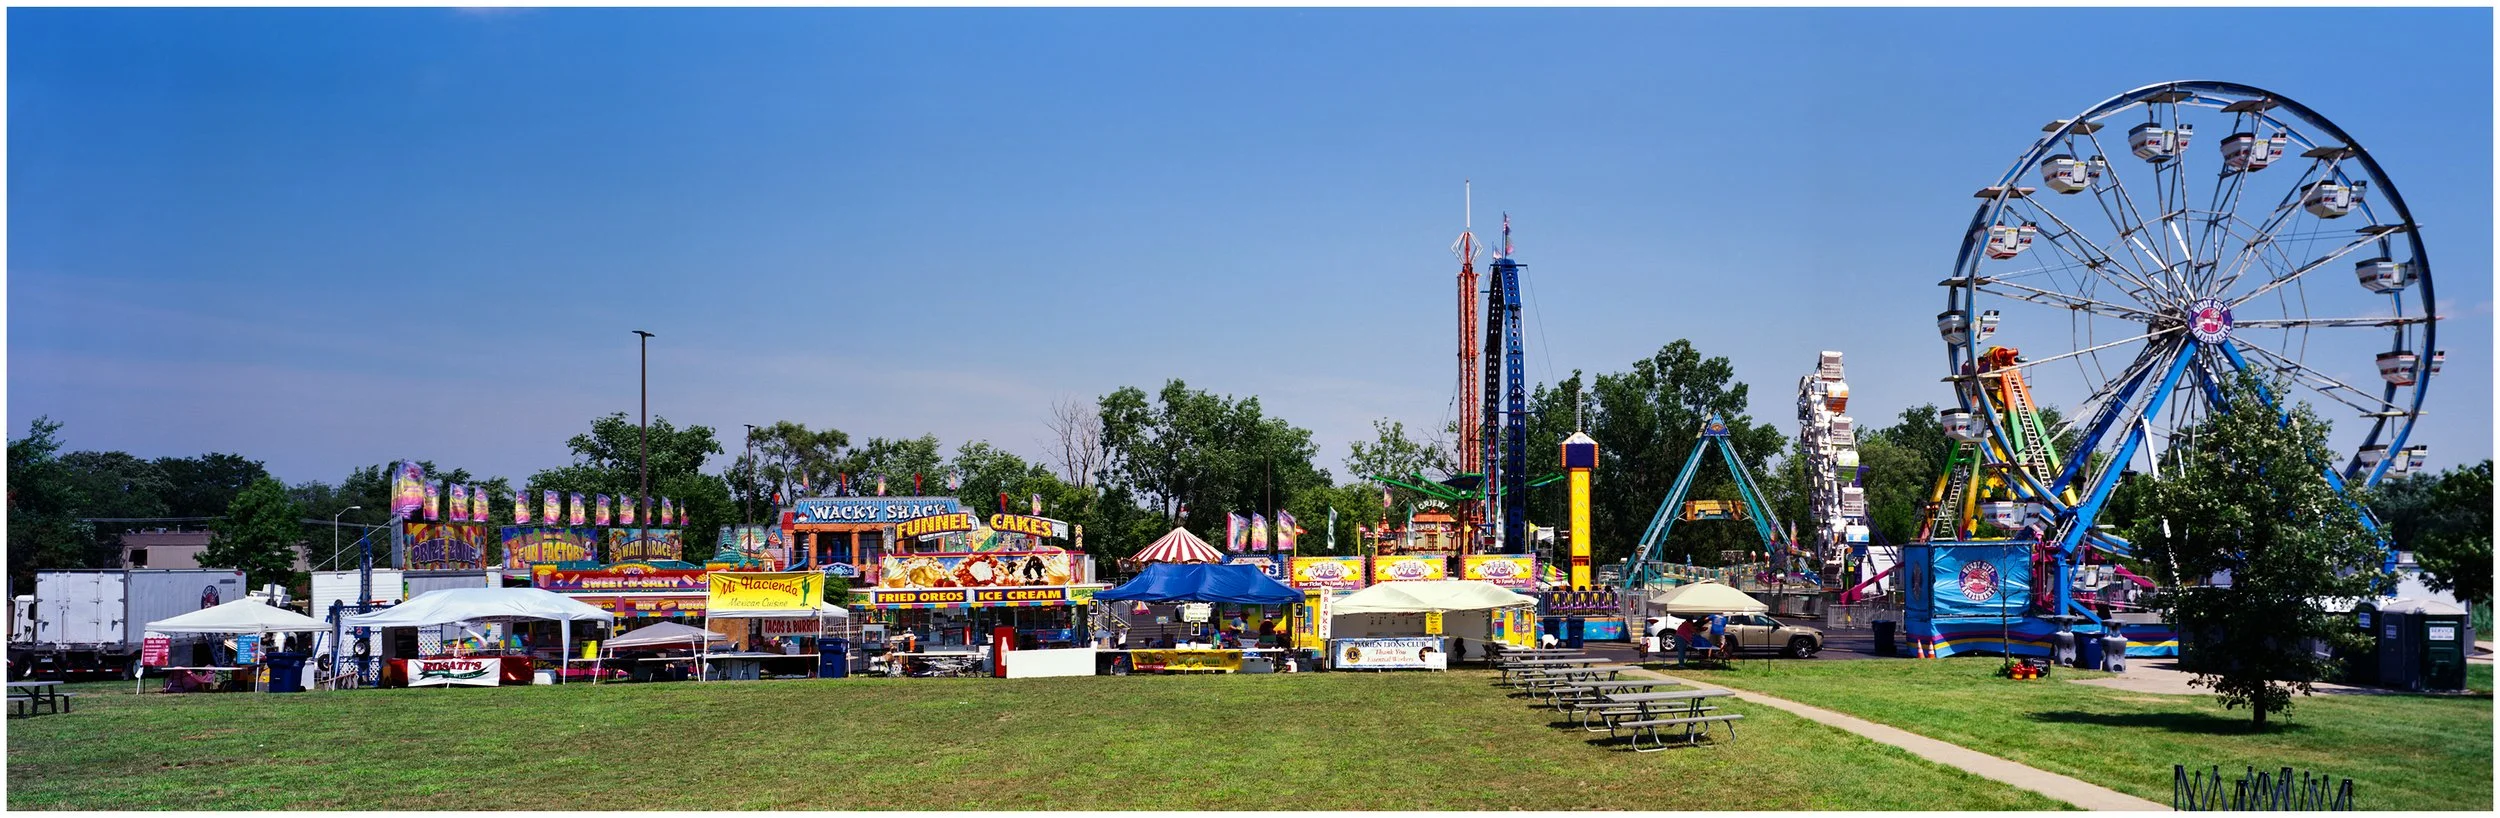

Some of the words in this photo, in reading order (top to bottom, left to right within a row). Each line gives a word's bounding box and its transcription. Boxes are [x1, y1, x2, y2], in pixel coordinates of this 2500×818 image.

[809, 504, 879, 520] WACKY
[886, 503, 949, 519] SHACK
[896, 513, 971, 540] FUNNEL
[990, 513, 1053, 537] CAKES
[411, 538, 446, 564] PRIZE
[448, 537, 477, 562] ZONE
[518, 542, 538, 561] FUN
[541, 540, 585, 562] FACTORY
[651, 540, 671, 557] RACE
[622, 567, 644, 575] WCA
[1313, 568, 1343, 577] WCA
[1396, 567, 1426, 576] WCA
[1486, 566, 1514, 574] WCA
[1962, 561, 1981, 574] WINDY
[1982, 561, 1995, 574] CITY
[581, 577, 680, 588] SWEET-N-SALTY
[718, 581, 736, 599] Mi
[740, 576, 798, 597] Hacienda
[878, 592, 917, 602] FRIED
[919, 591, 964, 601] OREOS
[978, 591, 1003, 600] ICE
[1006, 590, 1061, 600] CREAM
[635, 600, 659, 610] HOT
[728, 598, 760, 607] Mexican
[761, 597, 788, 608] Cuisine
[764, 619, 785, 633] TACOS
[786, 620, 792, 633] &
[422, 661, 482, 671] ROSATI'S
